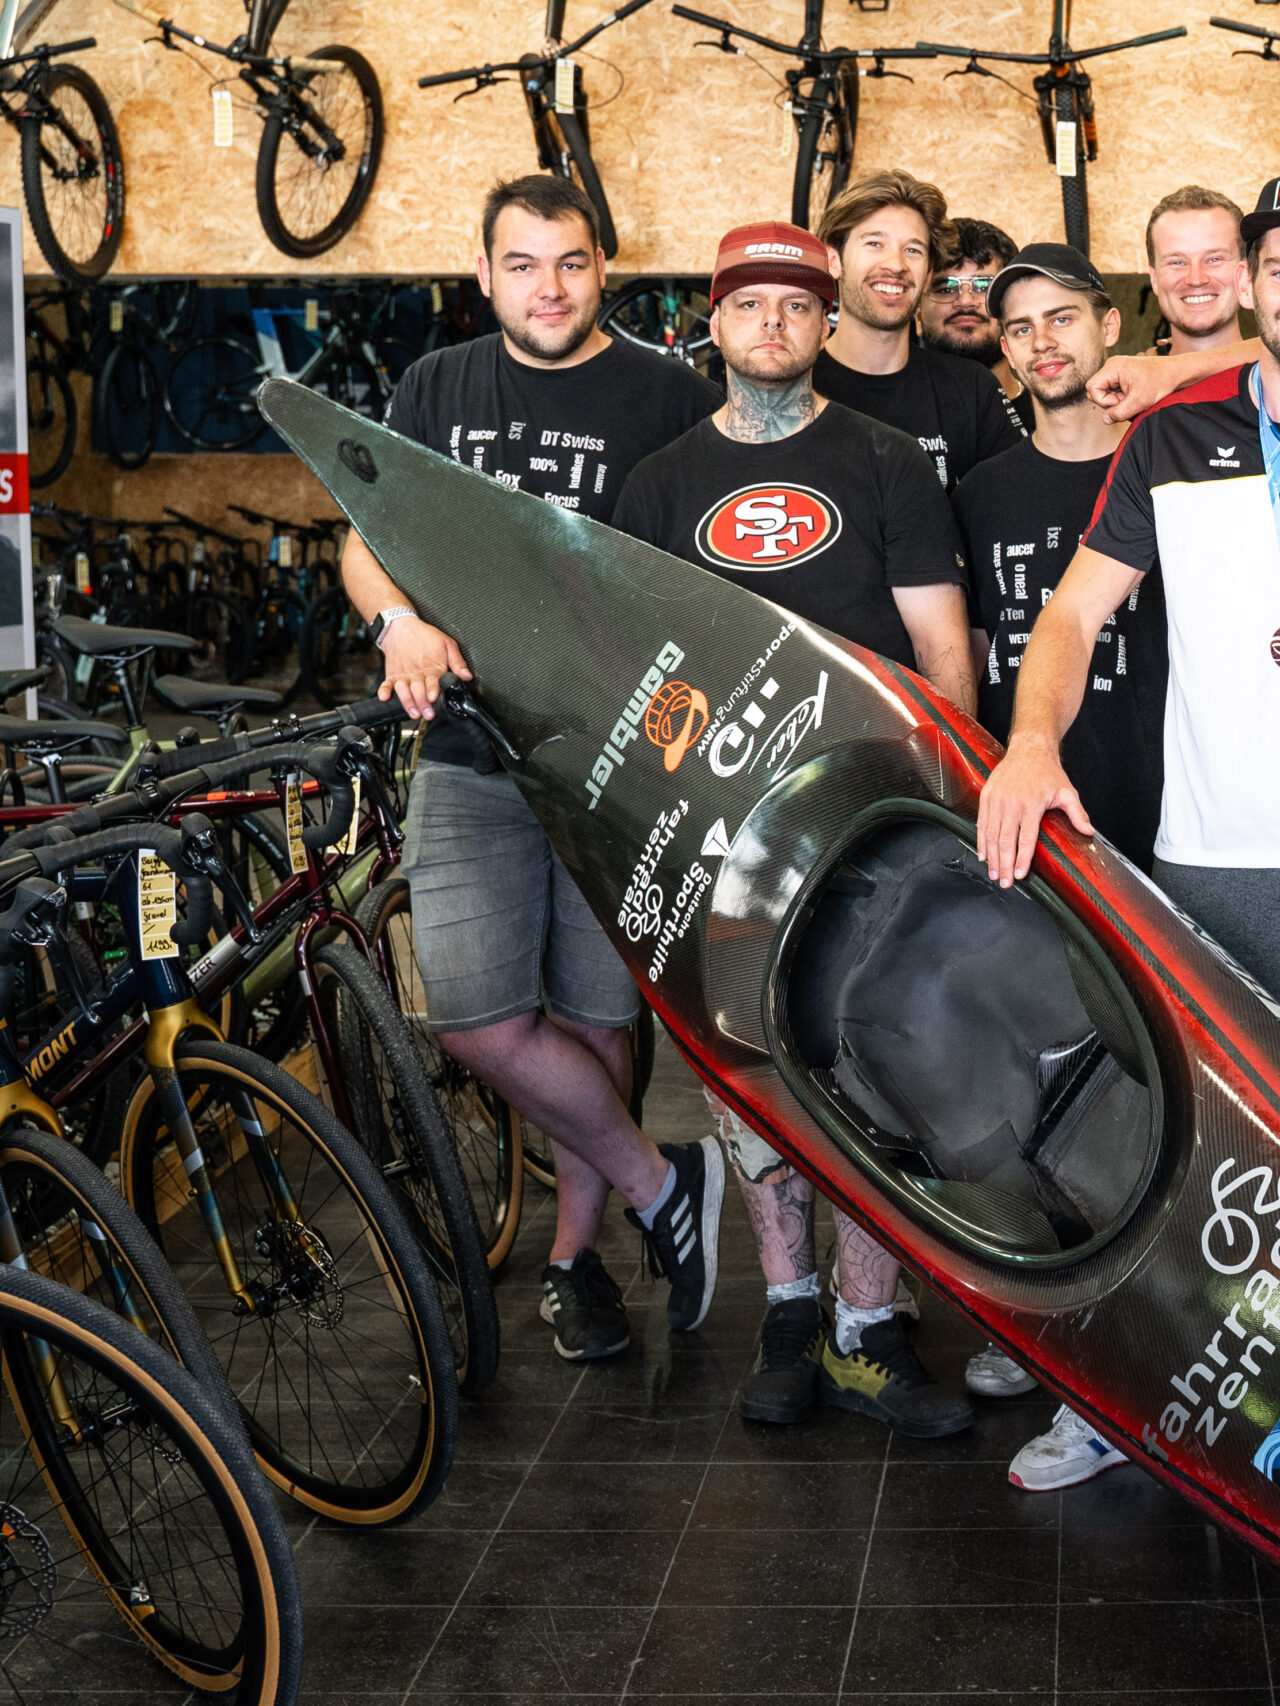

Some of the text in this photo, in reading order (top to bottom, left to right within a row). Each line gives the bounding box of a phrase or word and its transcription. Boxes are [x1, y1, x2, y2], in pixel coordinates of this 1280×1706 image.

[743, 242, 804, 259] SRAM
[467, 430, 497, 441] aucer
[541, 430, 605, 451] DT Swiss
[529, 457, 558, 473] 100%
[569, 453, 585, 489] kubikes
[1209, 459, 1240, 468] erima
[594, 463, 608, 494] conway
[734, 494, 814, 559] SF
[1007, 543, 1035, 557] aucer
[1093, 675, 1113, 692] ion
[632, 799, 689, 912] fahrrad
[617, 811, 669, 927] zentrale
[678, 872, 712, 938] Deutsche
[648, 861, 705, 982] Sporthilfe
